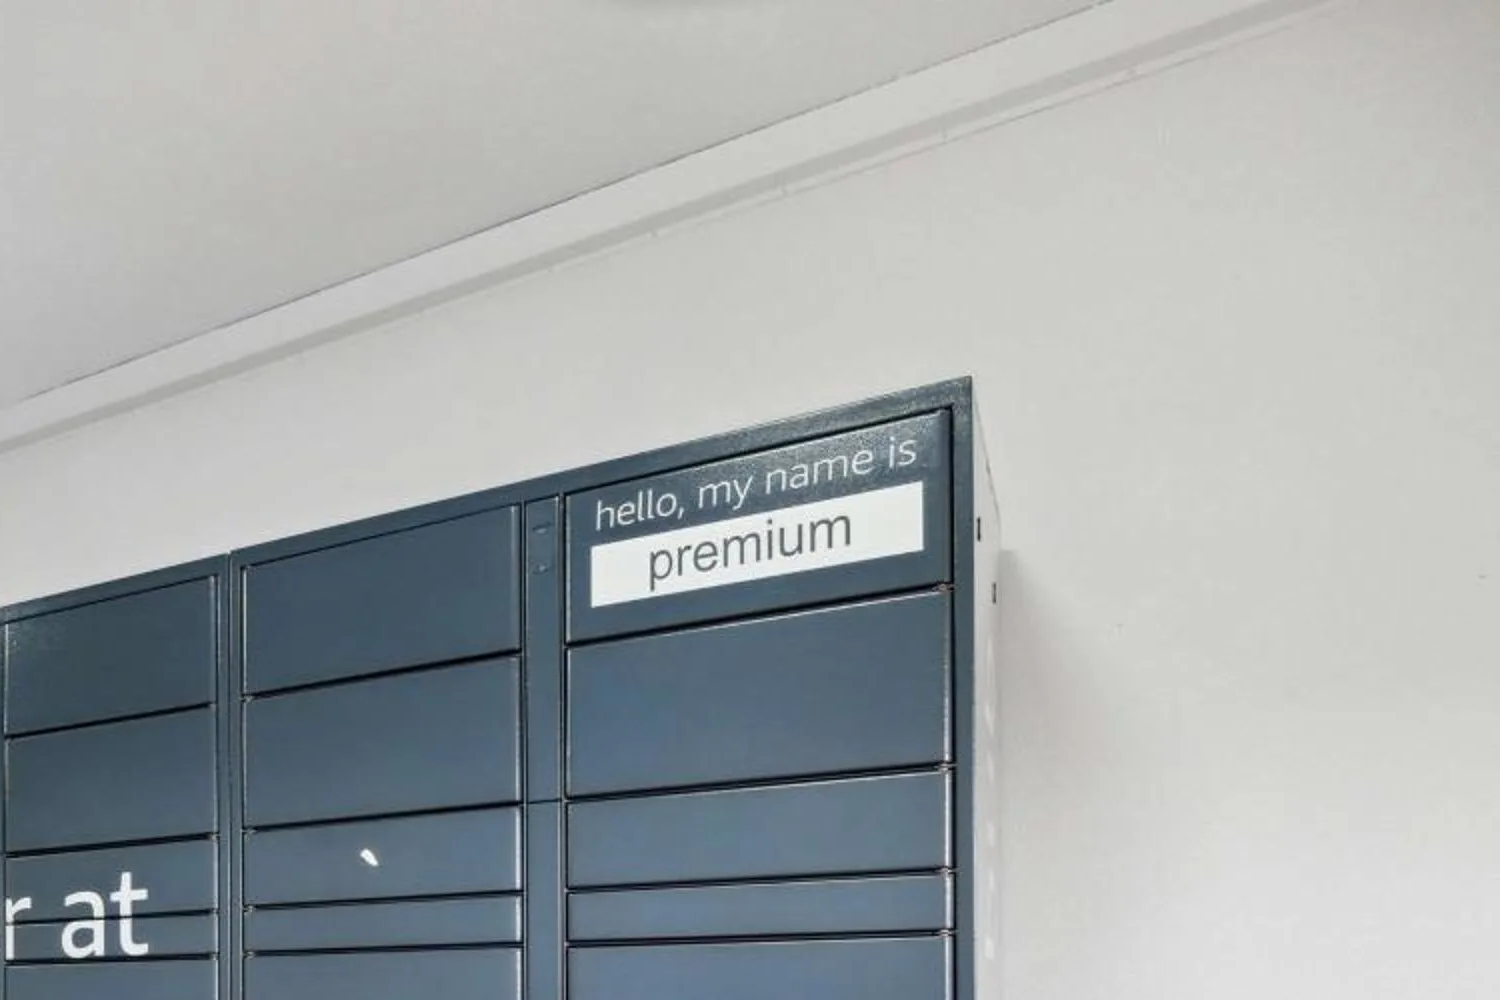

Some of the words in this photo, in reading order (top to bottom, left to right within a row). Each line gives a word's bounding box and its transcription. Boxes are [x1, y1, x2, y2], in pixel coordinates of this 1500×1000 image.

[596, 489, 684, 531] hello,
[699, 476, 752, 510] my
[765, 451, 873, 495] name
[889, 437, 918, 468] is
[650, 514, 851, 591] premium
[61, 871, 149, 958] at
